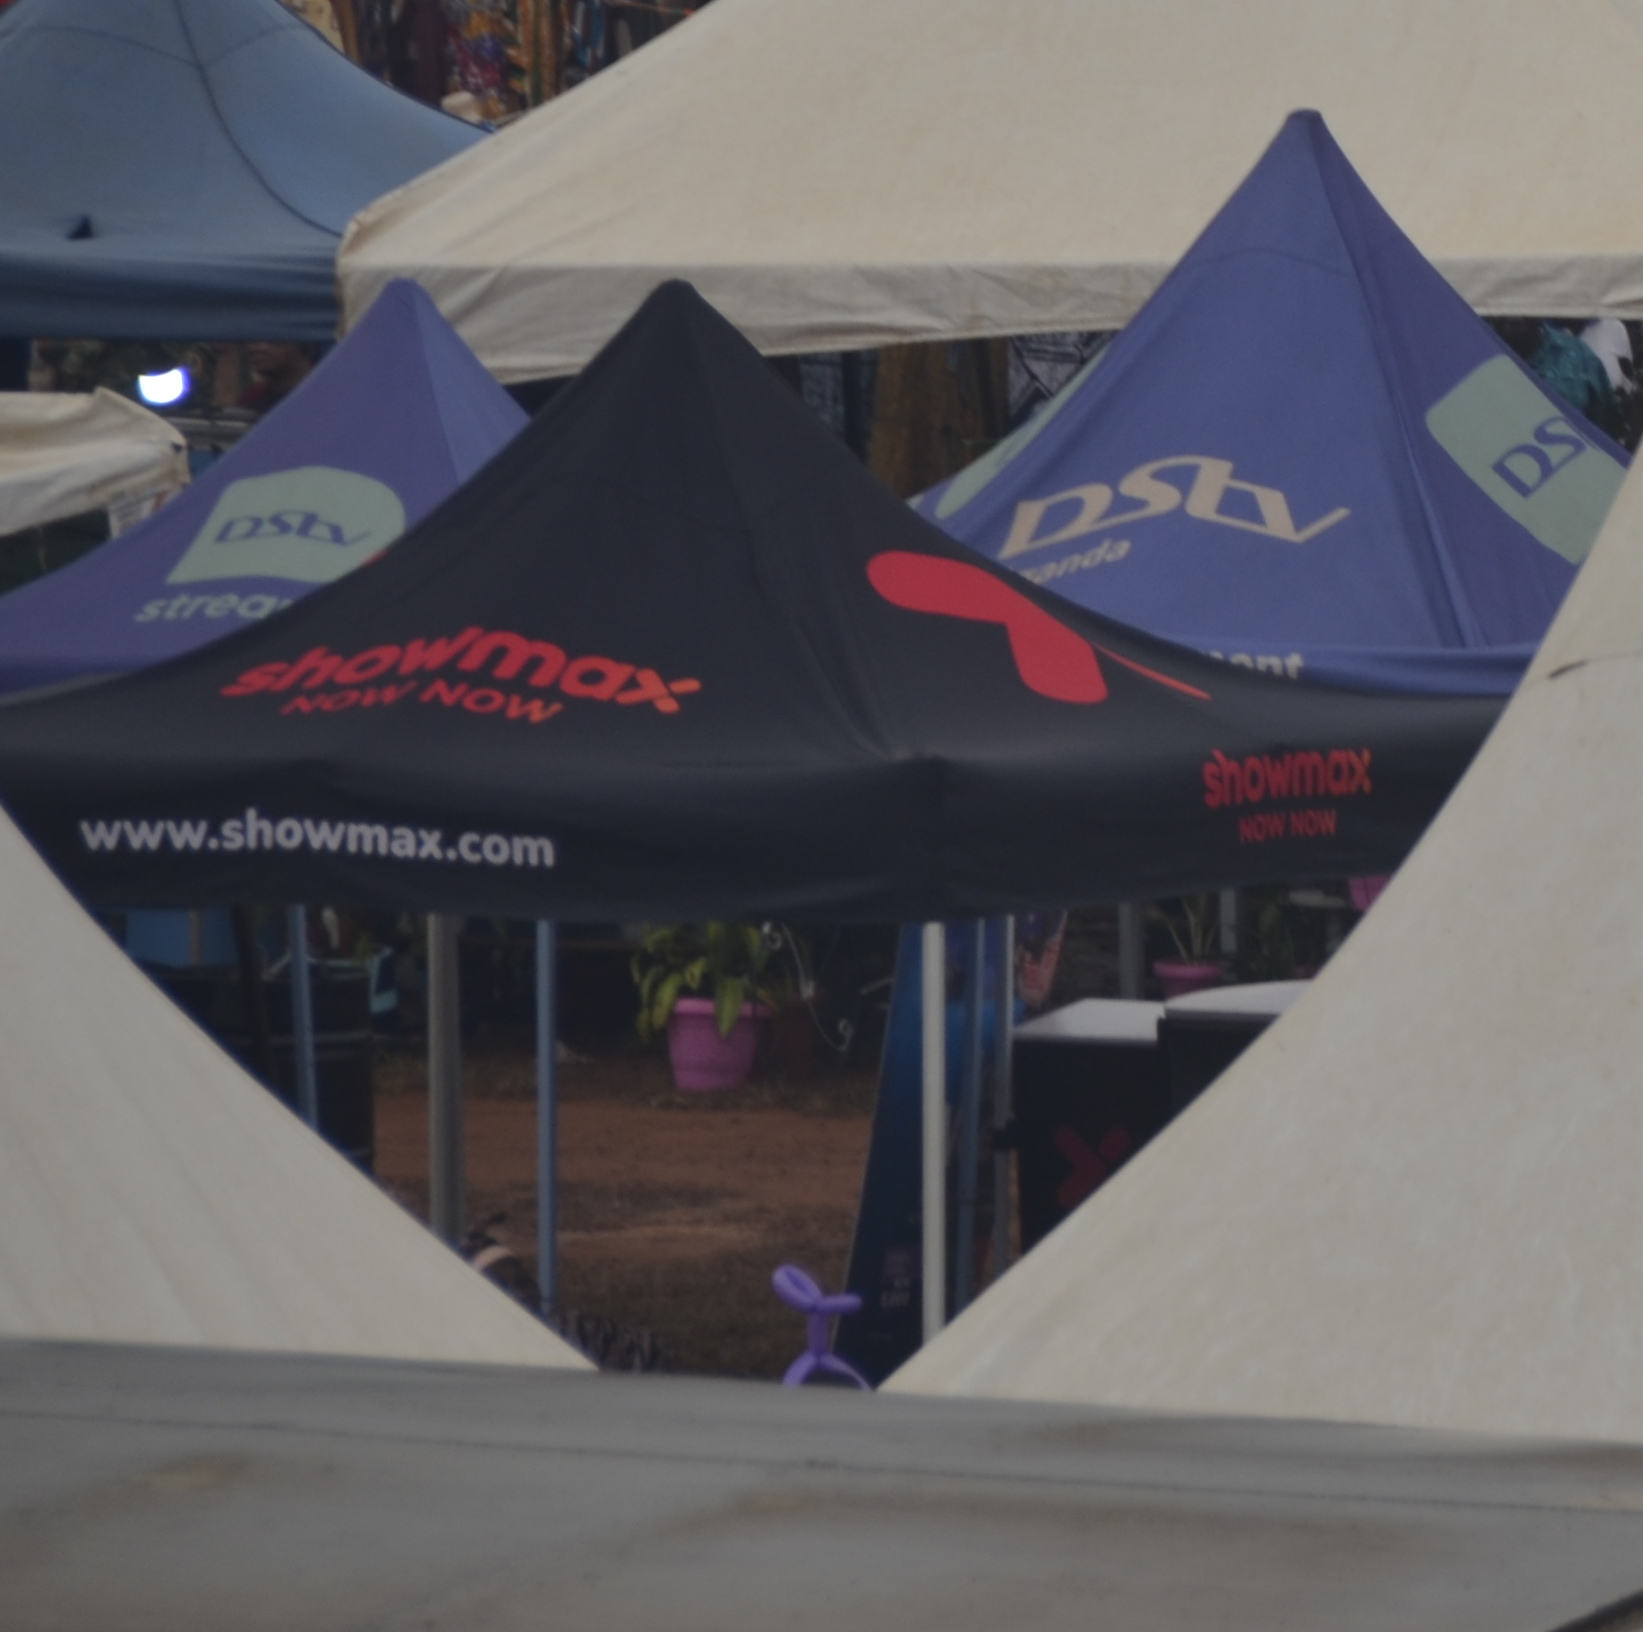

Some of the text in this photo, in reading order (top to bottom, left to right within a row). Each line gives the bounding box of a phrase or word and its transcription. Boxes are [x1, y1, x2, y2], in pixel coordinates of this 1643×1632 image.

[1010, 537, 1132, 586] anda
[134, 591, 297, 623] strea
[220, 625, 703, 715] showmax
[279, 678, 564, 725] NOW NOW
[1203, 747, 1373, 810] showmax
[79, 806, 557, 869] www.showmax.com
[1239, 808, 1338, 845] NOW NOW
